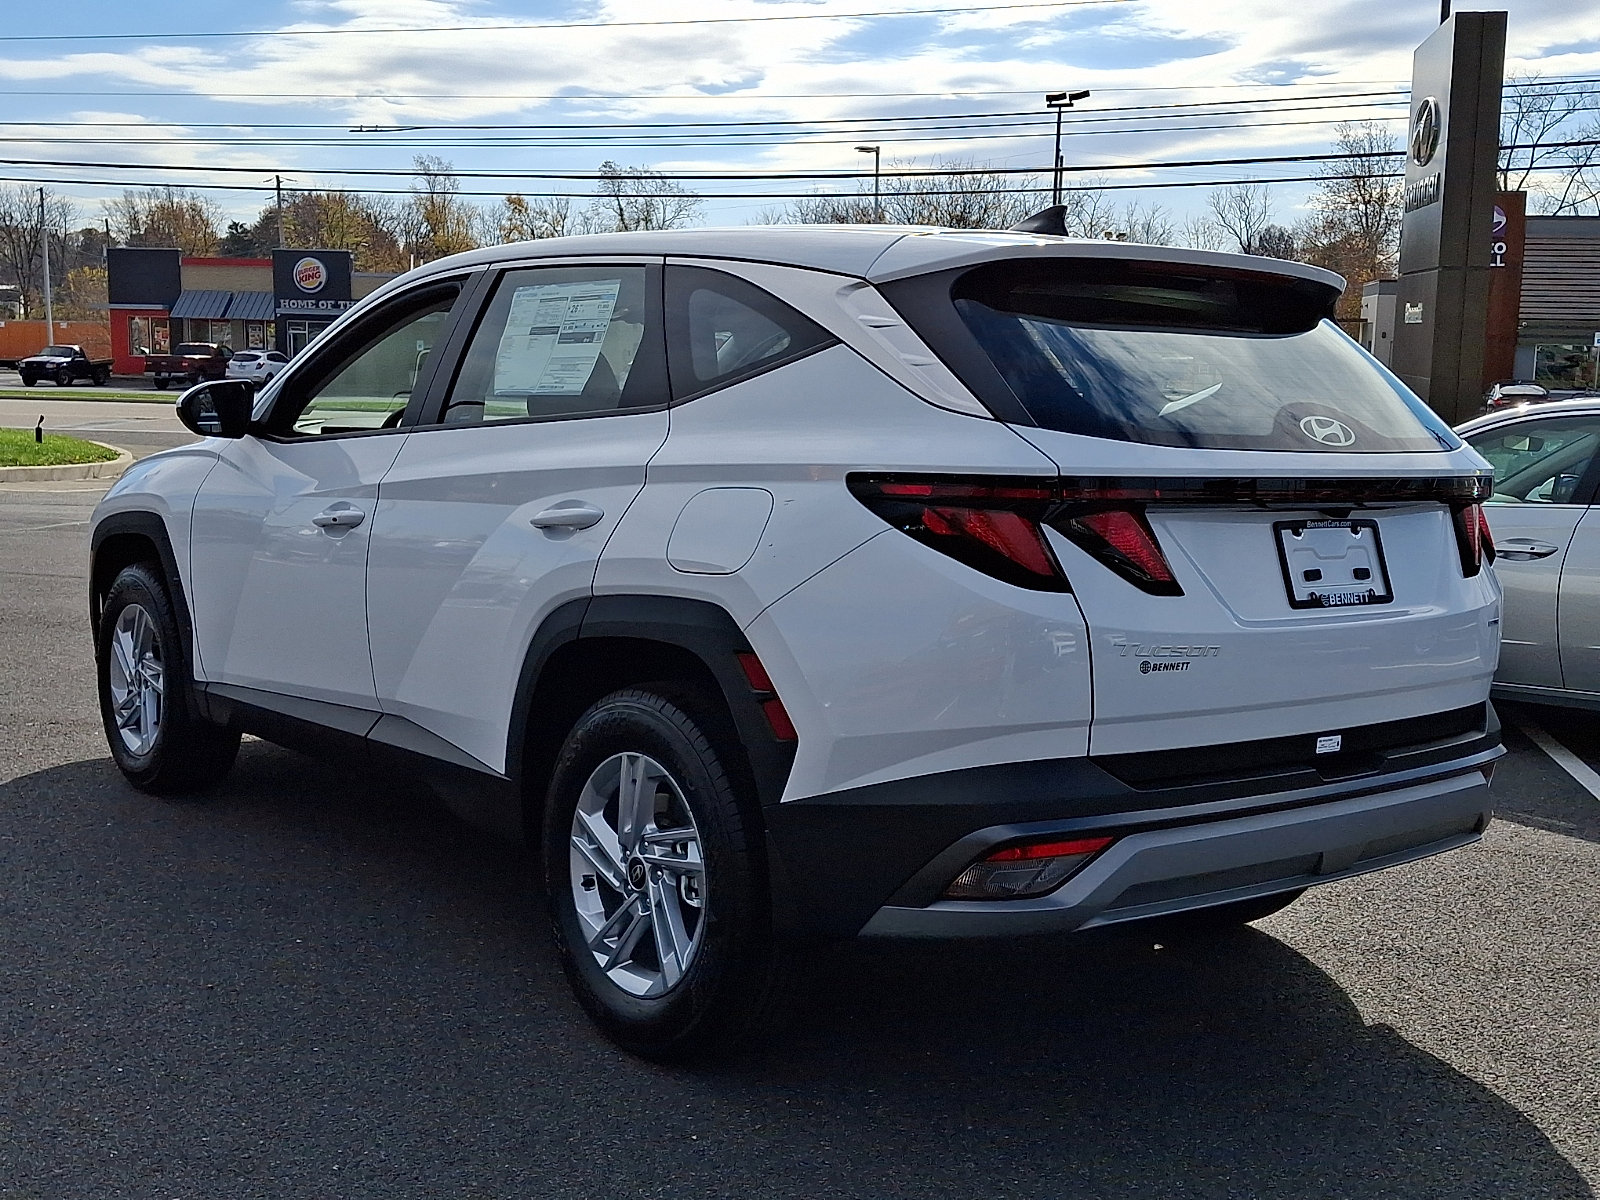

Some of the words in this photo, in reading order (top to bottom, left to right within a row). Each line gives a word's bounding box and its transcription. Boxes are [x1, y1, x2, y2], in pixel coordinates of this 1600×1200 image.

[298, 265, 320, 277] BURGER
[298, 271, 321, 284] KING
[280, 299, 316, 309] HOME
[318, 300, 335, 310] OF
[337, 300, 357, 310] TH
[1306, 520, 1351, 528] BennettCars.com
[1329, 592, 1369, 605] BENNETT
[1151, 661, 1191, 672] BENNETT
